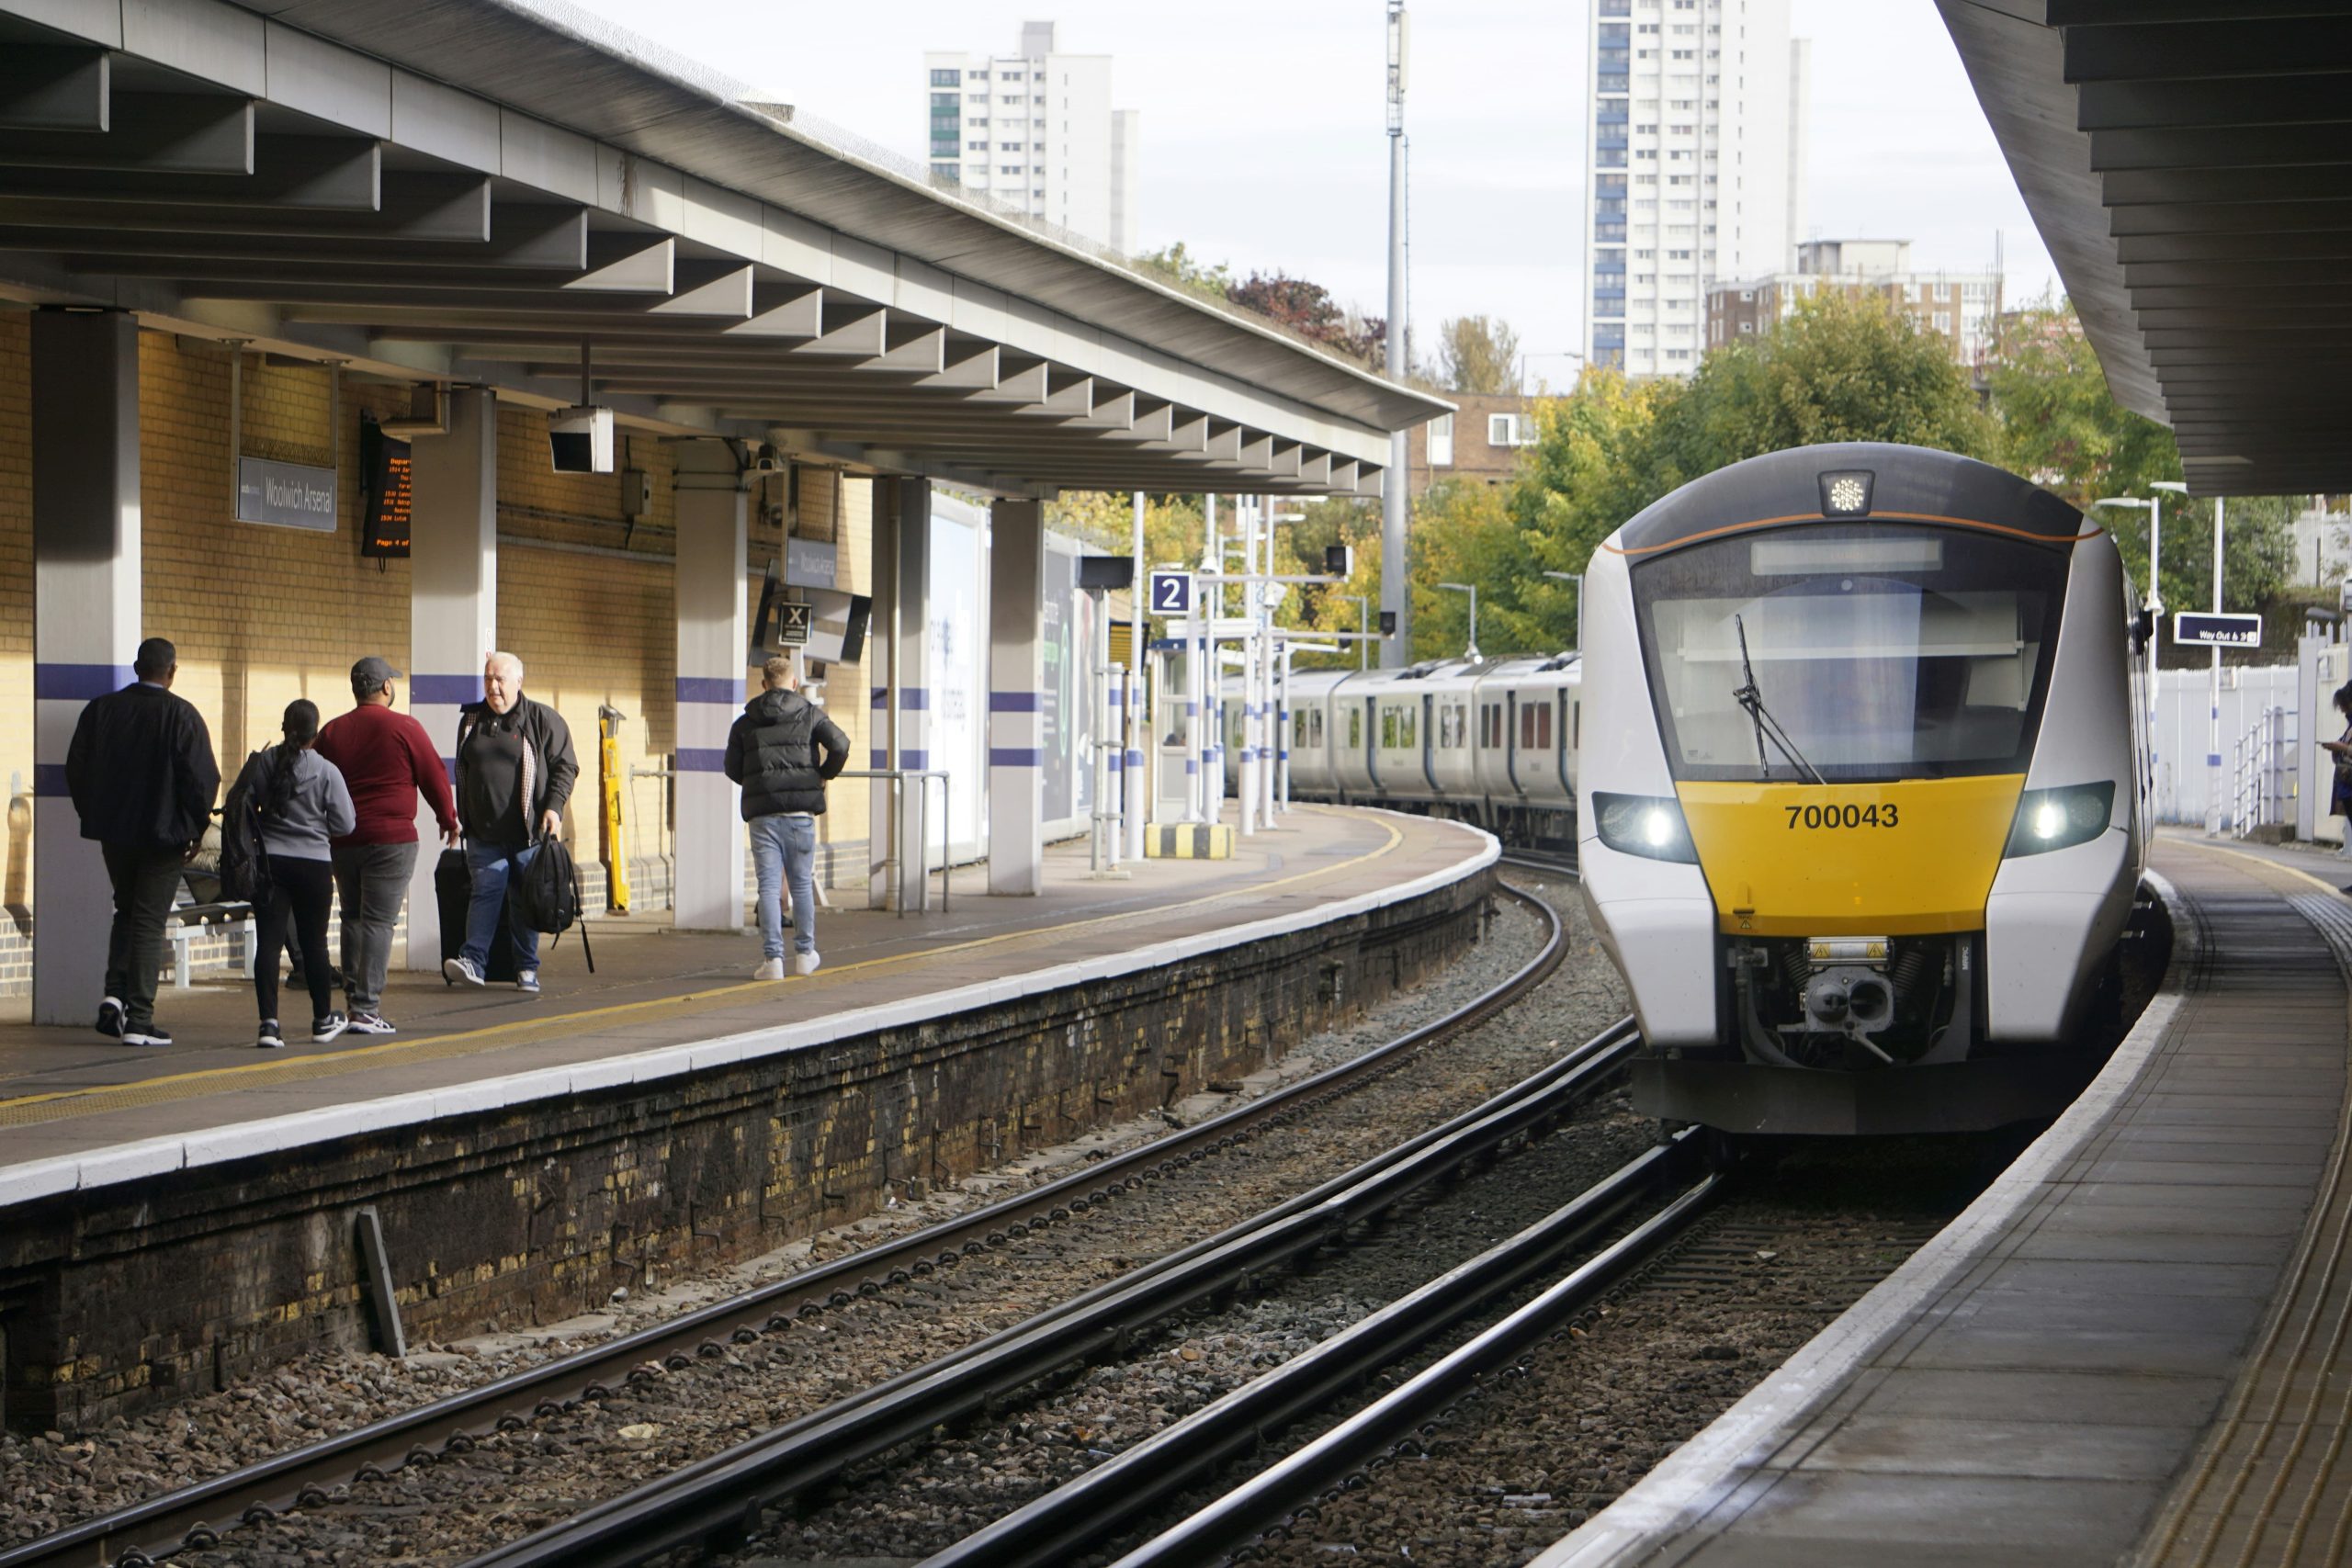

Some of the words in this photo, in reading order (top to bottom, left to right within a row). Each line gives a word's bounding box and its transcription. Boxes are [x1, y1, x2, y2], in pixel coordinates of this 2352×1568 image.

[266, 477, 303, 511] Woolwich
[304, 482, 333, 513] Arsenal
[377, 538, 392, 547] Page
[1162, 578, 1181, 608] 2
[788, 607, 803, 625] X
[2199, 630, 2214, 640] Way
[2216, 630, 2230, 641] Out
[1785, 804, 1899, 829] 700043
